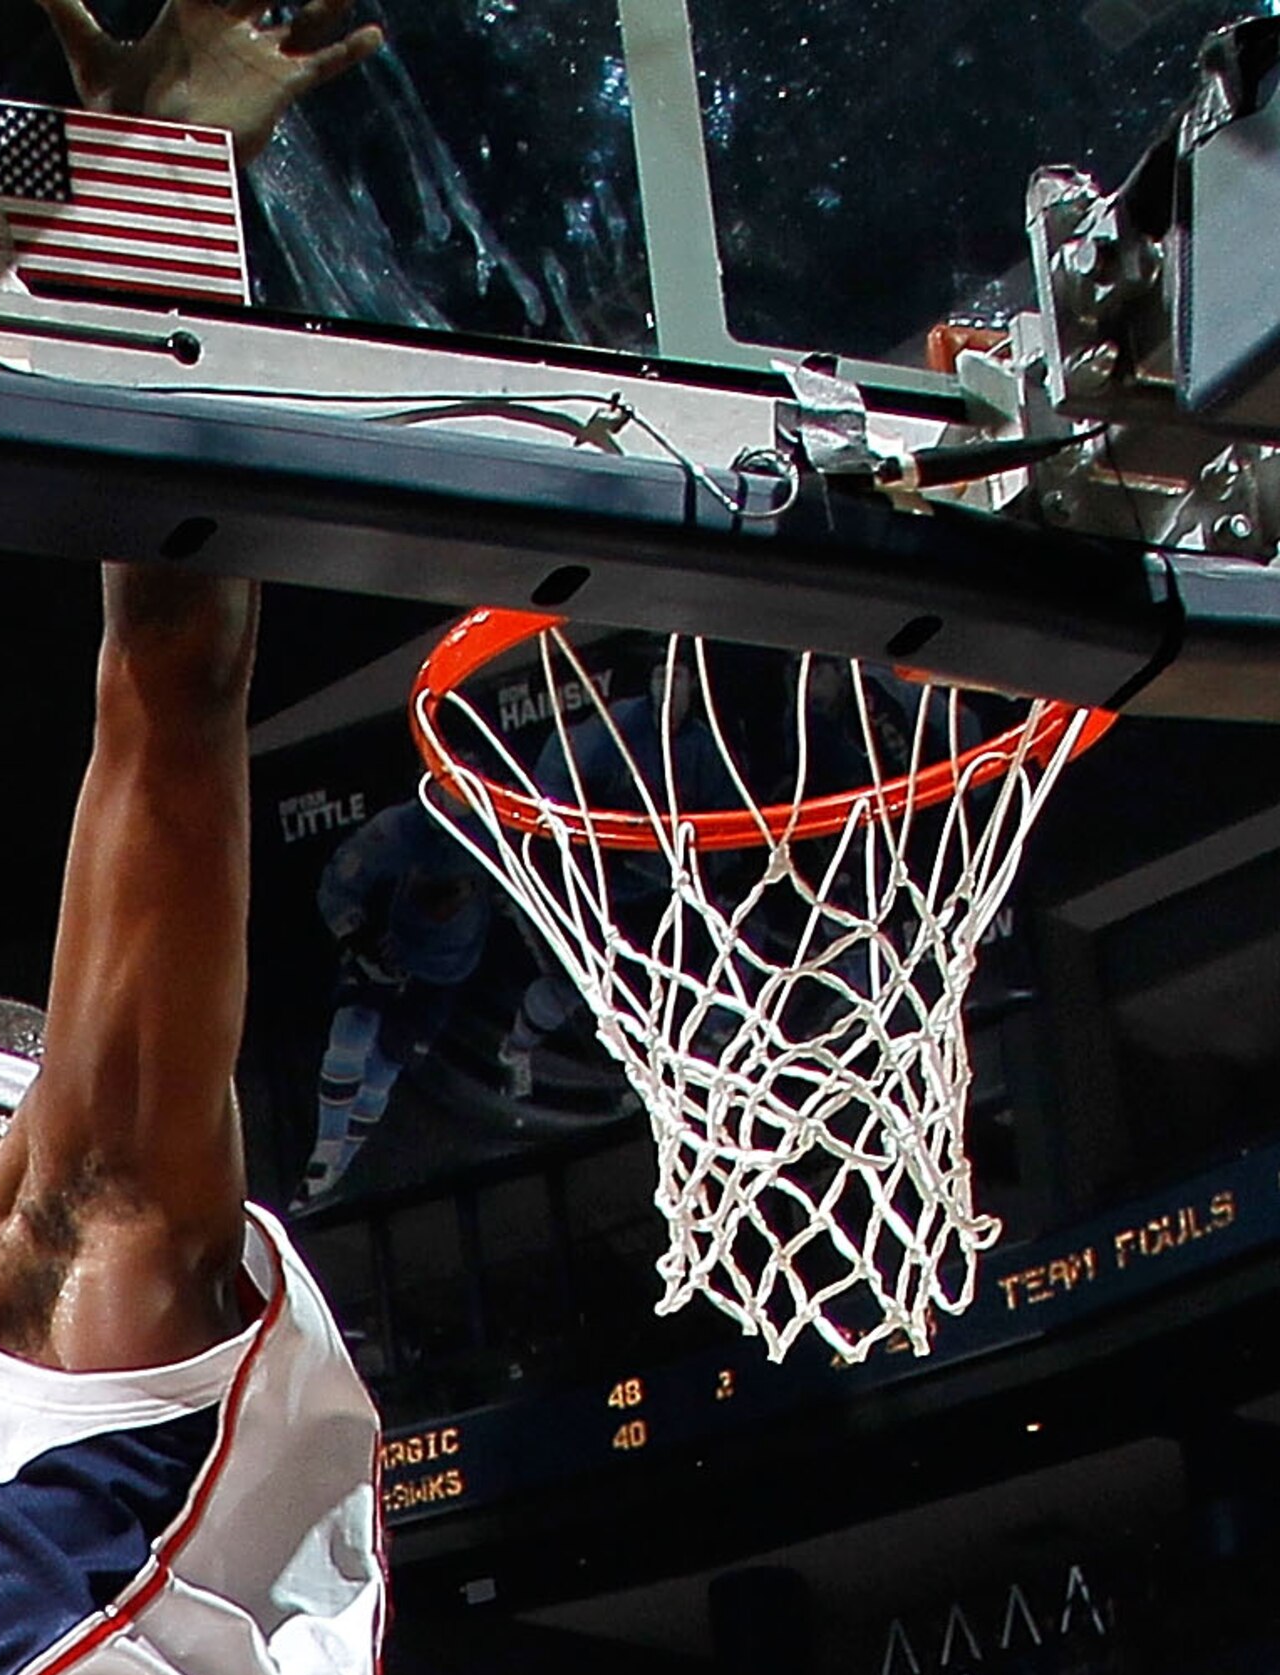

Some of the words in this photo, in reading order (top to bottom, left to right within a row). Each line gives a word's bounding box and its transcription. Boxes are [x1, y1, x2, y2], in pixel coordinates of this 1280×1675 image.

[280, 791, 367, 844] LITTLE
[998, 1247, 1098, 1310] TEAM
[1114, 1190, 1234, 1269] FOULS
[607, 1378, 642, 1409] 48
[613, 1420, 646, 1450] 40
